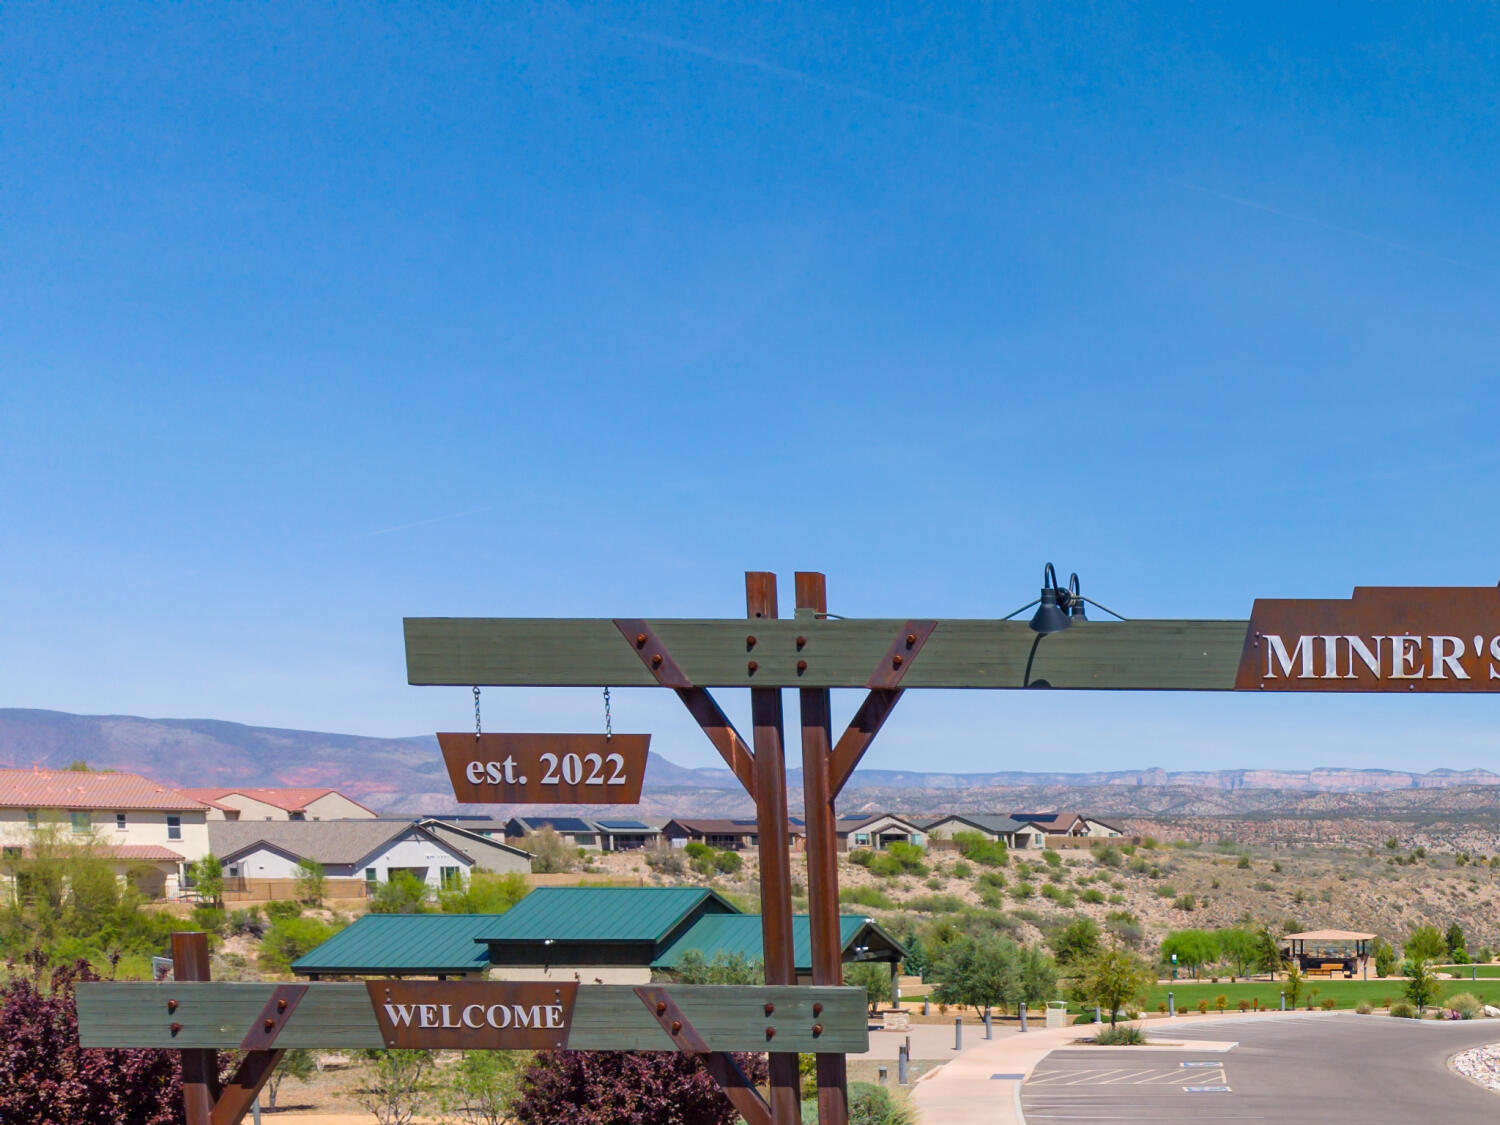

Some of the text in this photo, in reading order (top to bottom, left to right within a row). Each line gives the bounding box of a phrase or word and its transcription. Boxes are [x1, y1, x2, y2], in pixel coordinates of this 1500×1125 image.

[466, 752, 627, 785] est. 2022
[383, 1003, 565, 1029] WELCOME
